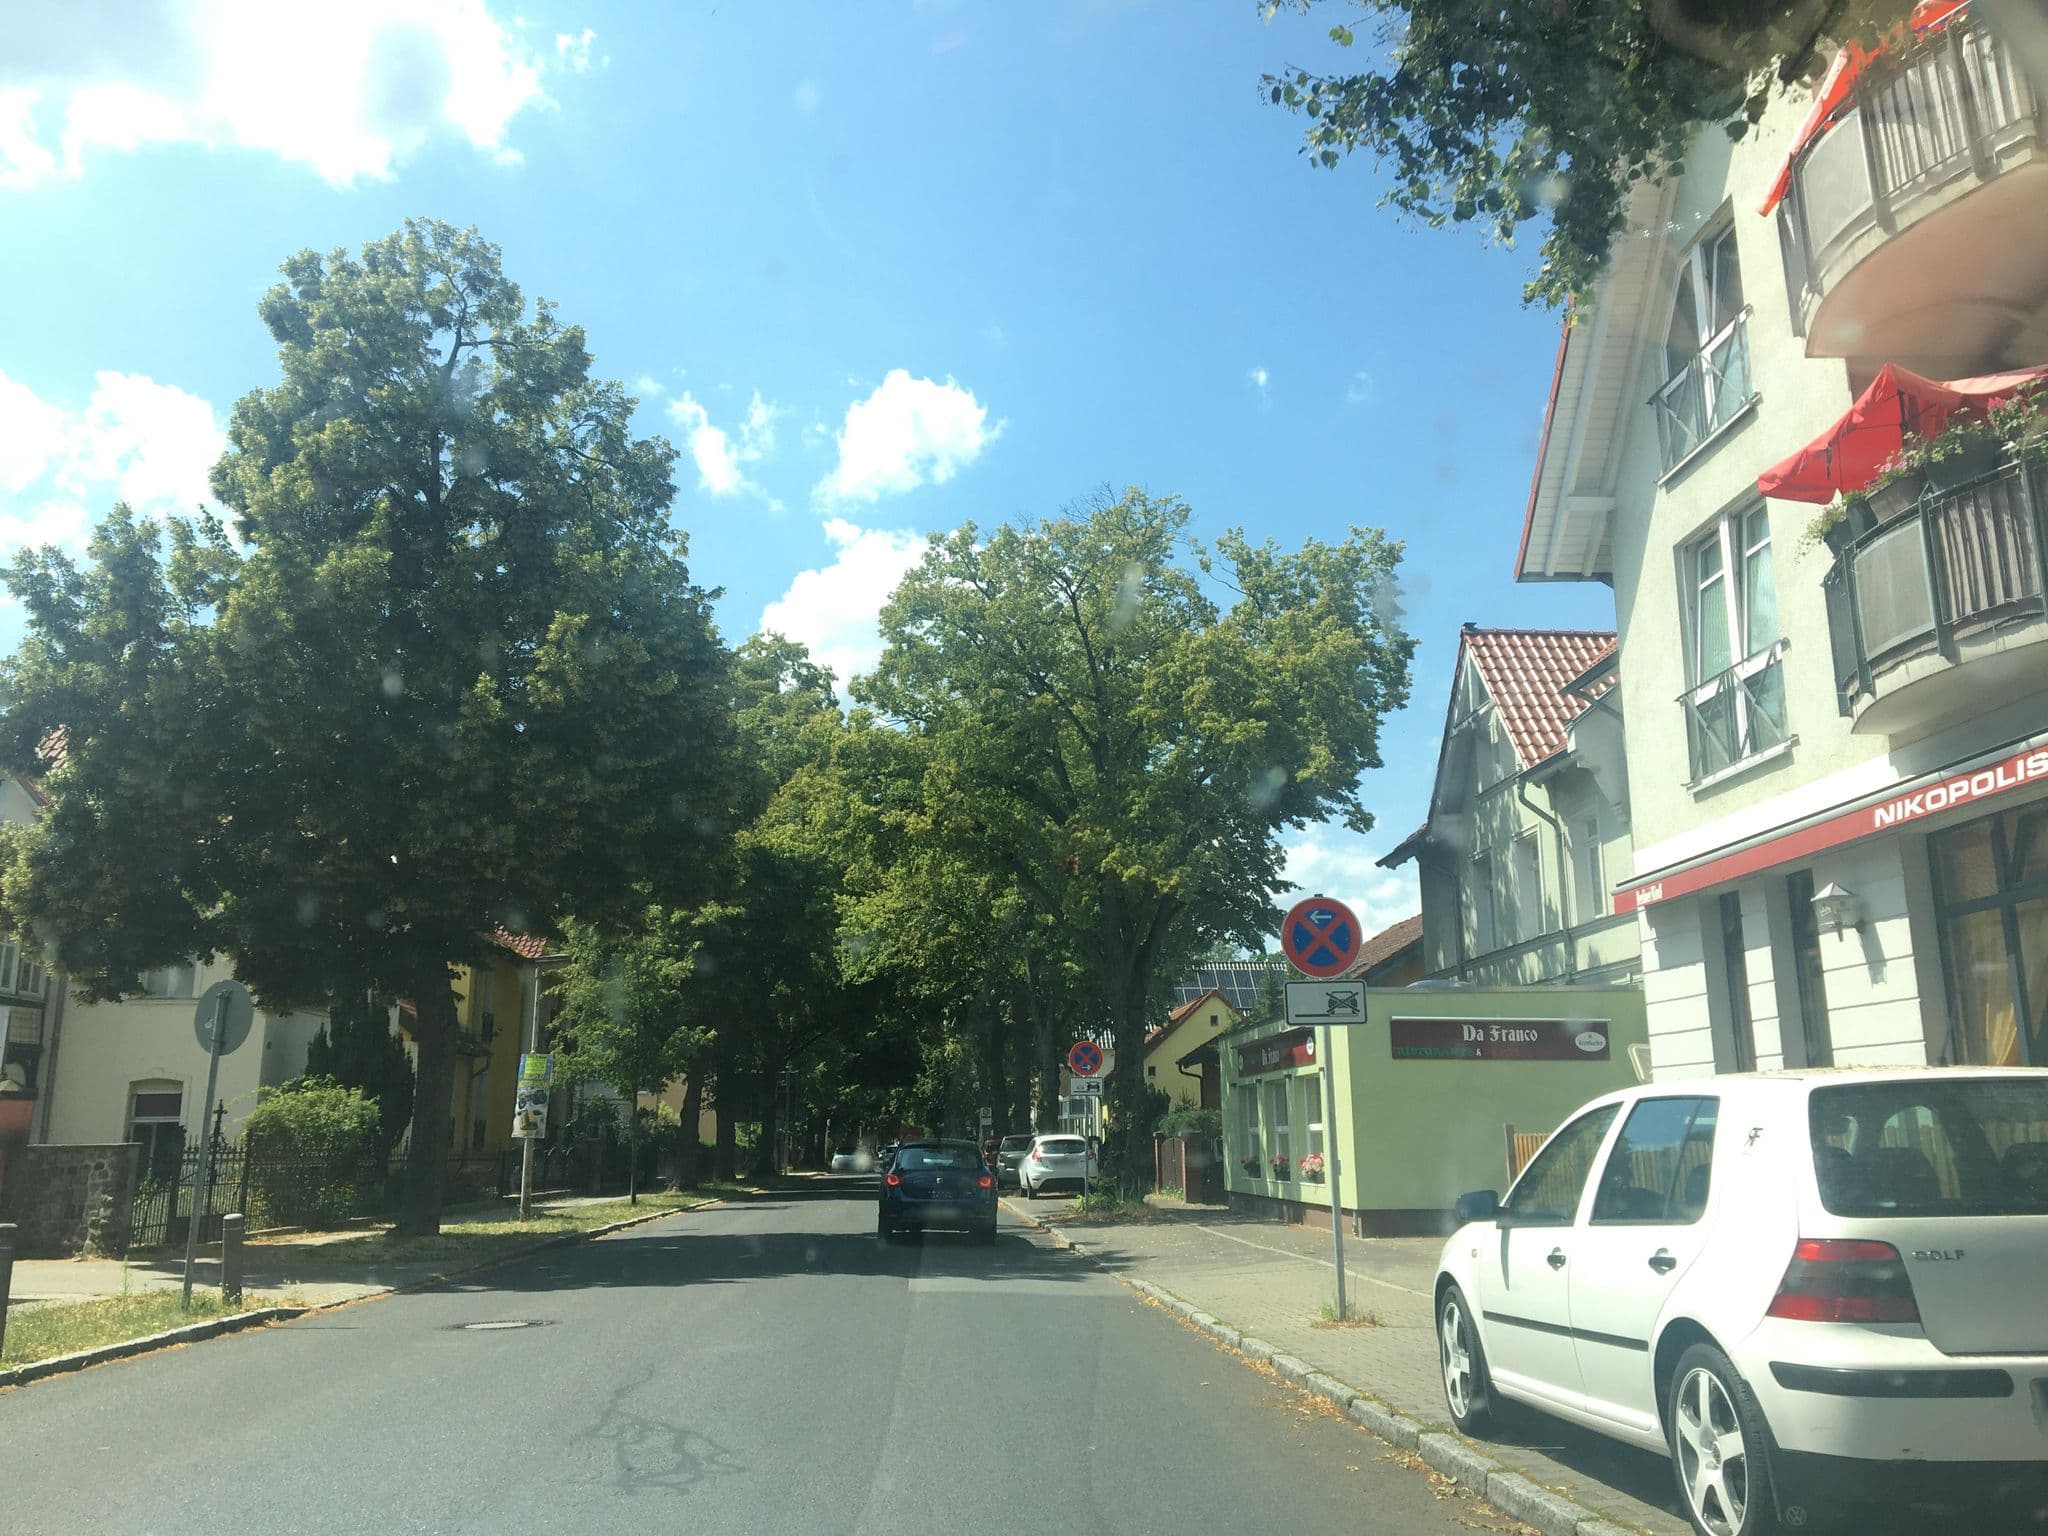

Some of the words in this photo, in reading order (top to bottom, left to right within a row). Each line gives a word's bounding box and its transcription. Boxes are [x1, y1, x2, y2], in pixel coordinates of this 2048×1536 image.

[1874, 751, 2048, 828] NIKOPOLIS
[1461, 1024, 1484, 1041] Da
[1489, 1025, 1538, 1042] Franco
[1912, 1249, 1966, 1261] GOLF
